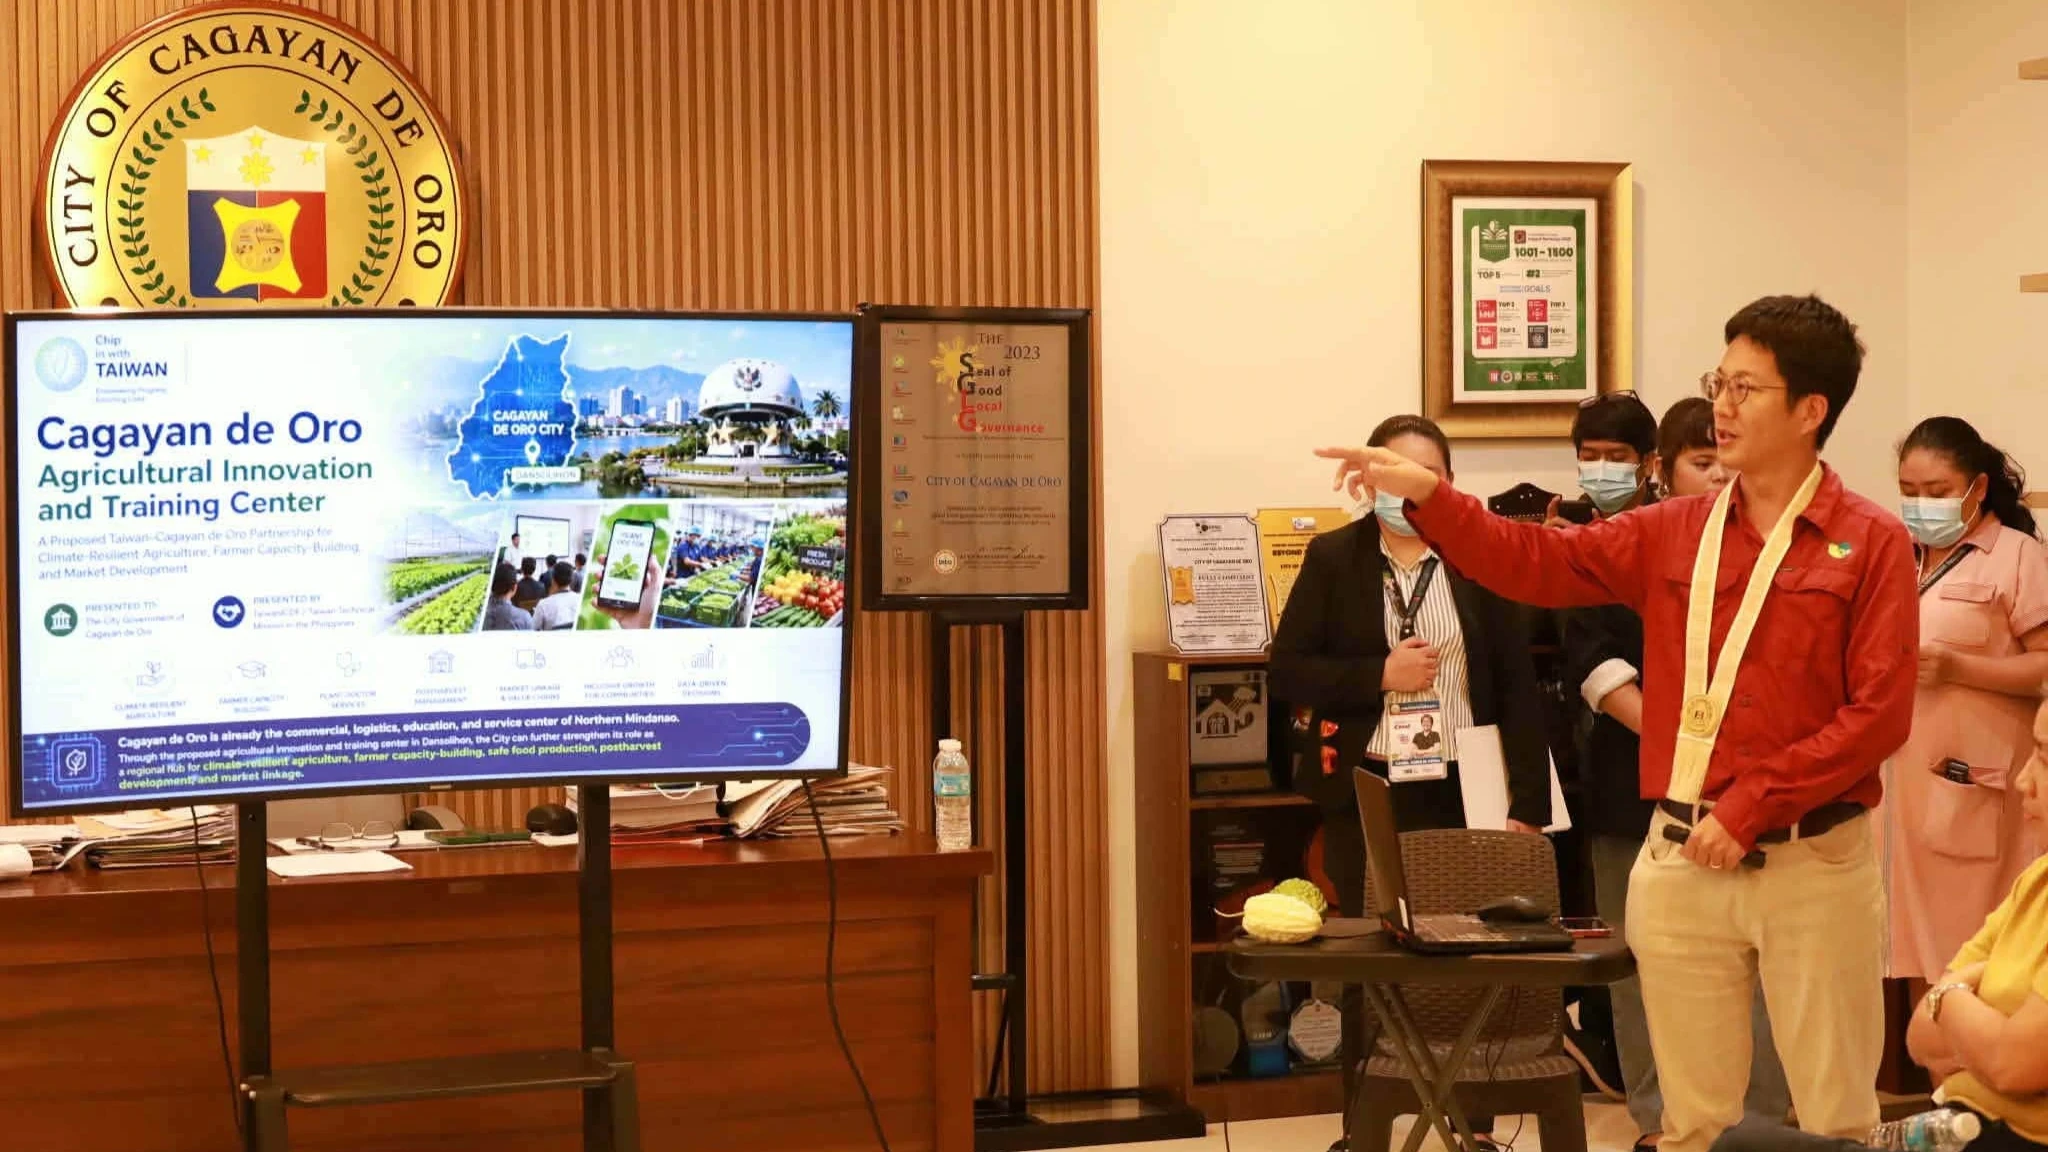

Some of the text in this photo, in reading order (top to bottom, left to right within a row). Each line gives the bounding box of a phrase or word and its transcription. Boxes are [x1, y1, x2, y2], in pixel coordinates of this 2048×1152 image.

[64, 24, 447, 270] CITY OF CAGAYAN DE ORO
[1477, 271, 1495, 279] TOP
[95, 334, 122, 346] Chip
[977, 332, 1005, 344] THE
[107, 348, 131, 358] with
[1003, 345, 1041, 360] 2023
[95, 362, 168, 378] TAIWAN
[959, 351, 1011, 377] Seal of
[957, 372, 1003, 396] Good
[960, 389, 1003, 413] Local
[493, 410, 548, 422] CAGAYAN
[37, 410, 363, 457] Cagayan de Oro
[493, 423, 565, 436] DE ORO CITY
[37, 456, 373, 493] Agricultural Innovation
[926, 475, 950, 486] CITY
[969, 475, 1018, 487] CAGAYAN
[1038, 475, 1063, 487] ORO
[38, 490, 327, 521] and Training Center
[38, 536, 47, 546] A
[50, 532, 107, 548] Proposed
[207, 531, 223, 541] de
[225, 529, 247, 540] Oro
[250, 525, 315, 539] Partnership
[317, 527, 333, 536] for
[38, 549, 139, 563] Climate-Resilient
[213, 545, 255, 556] Farmer
[38, 563, 189, 580] and Market Development
[117, 711, 680, 749] Cagayan de Oro is already the commercial, logistics, education, and service center of Northern Mindanao.
[118, 753, 158, 766] Through
[159, 751, 175, 762] the
[177, 748, 221, 763] proposed
[223, 745, 275, 759] agricultural
[276, 742, 323, 754] innovation
[325, 741, 342, 751] and
[344, 739, 379, 752] training
[381, 739, 409, 748] center
[411, 737, 420, 746] in
[475, 734, 490, 744] the
[492, 733, 511, 745] City
[512, 734, 529, 743] can
[530, 731, 560, 741] further
[562, 730, 611, 742] strengthen
[612, 729, 623, 738] its
[625, 729, 642, 739] role
[643, 730, 655, 738] as
[127, 764, 165, 777] regional
[188, 761, 201, 771] for
[291, 753, 351, 767] agriculture,
[354, 751, 389, 761] farmer
[391, 746, 486, 761] capacity-building,
[488, 746, 510, 756] safe
[512, 744, 536, 755] food
[538, 741, 598, 756] production,
[599, 741, 662, 754] postharvest
[198, 774, 219, 784] and
[221, 771, 260, 782] market
[262, 768, 305, 782] linkage.
